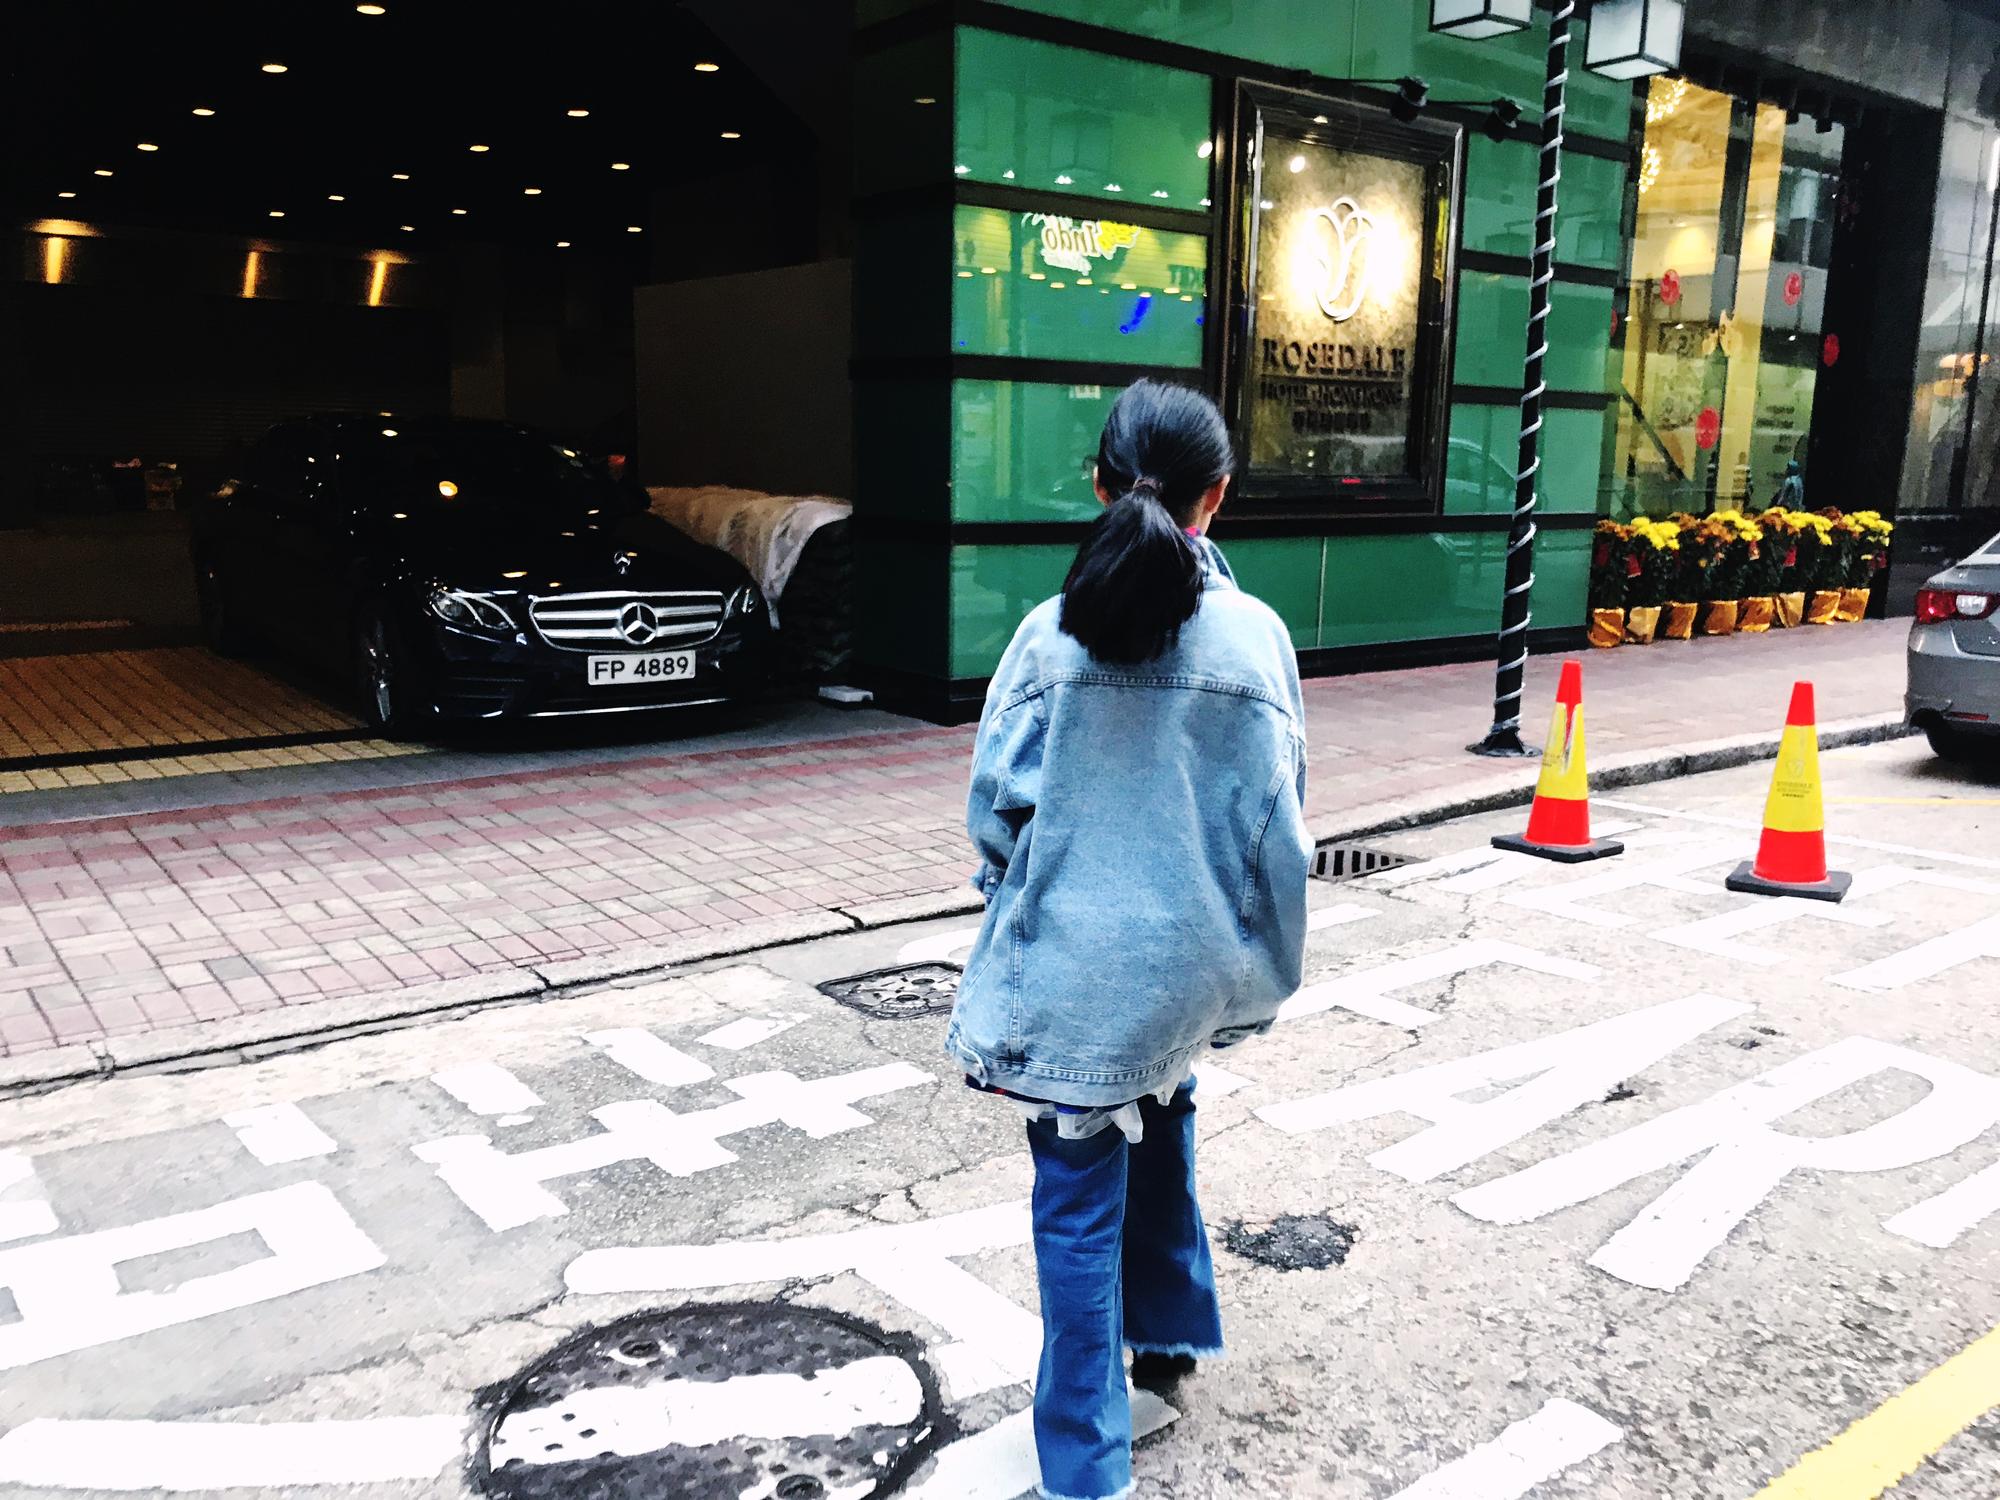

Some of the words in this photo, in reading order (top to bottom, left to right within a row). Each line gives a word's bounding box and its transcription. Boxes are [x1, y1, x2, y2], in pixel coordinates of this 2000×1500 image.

[1262, 338, 1406, 377] ROSEDALE
[594, 659, 625, 680] FP
[633, 656, 689, 677] 4889
